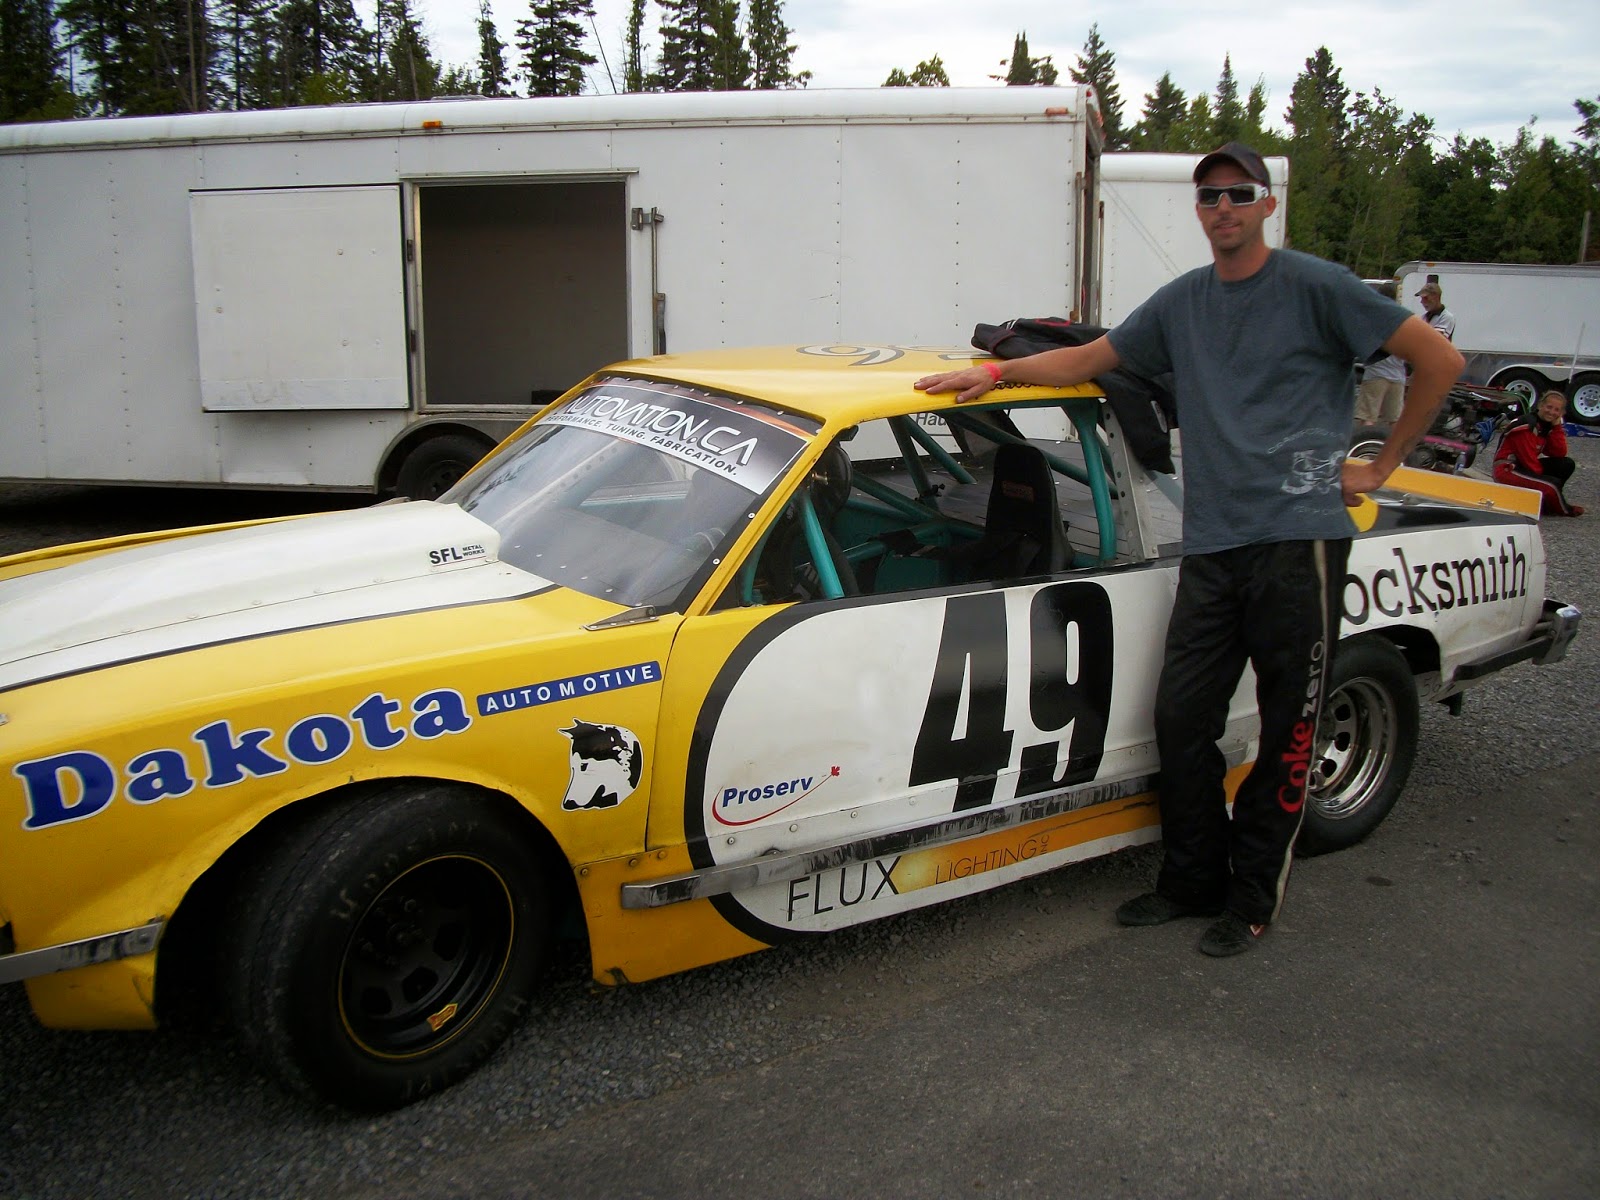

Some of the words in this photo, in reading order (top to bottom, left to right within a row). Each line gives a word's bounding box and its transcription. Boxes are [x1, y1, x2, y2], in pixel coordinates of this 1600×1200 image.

[606, 423, 645, 439] TUNING.
[649, 435, 738, 475] FABRICATION.
[429, 546, 463, 565] SFL
[463, 549, 485, 557] WORKS
[485, 665, 654, 713] AUTOMOTIVE
[908, 581, 1114, 813] 49
[1277, 721, 1313, 814] Coke
[1302, 640, 1324, 717] zero
[12, 688, 473, 831] Dakota
[722, 777, 814, 807] Proserv
[787, 856, 899, 921] FLUX
[934, 839, 1037, 884] LIGHTING
